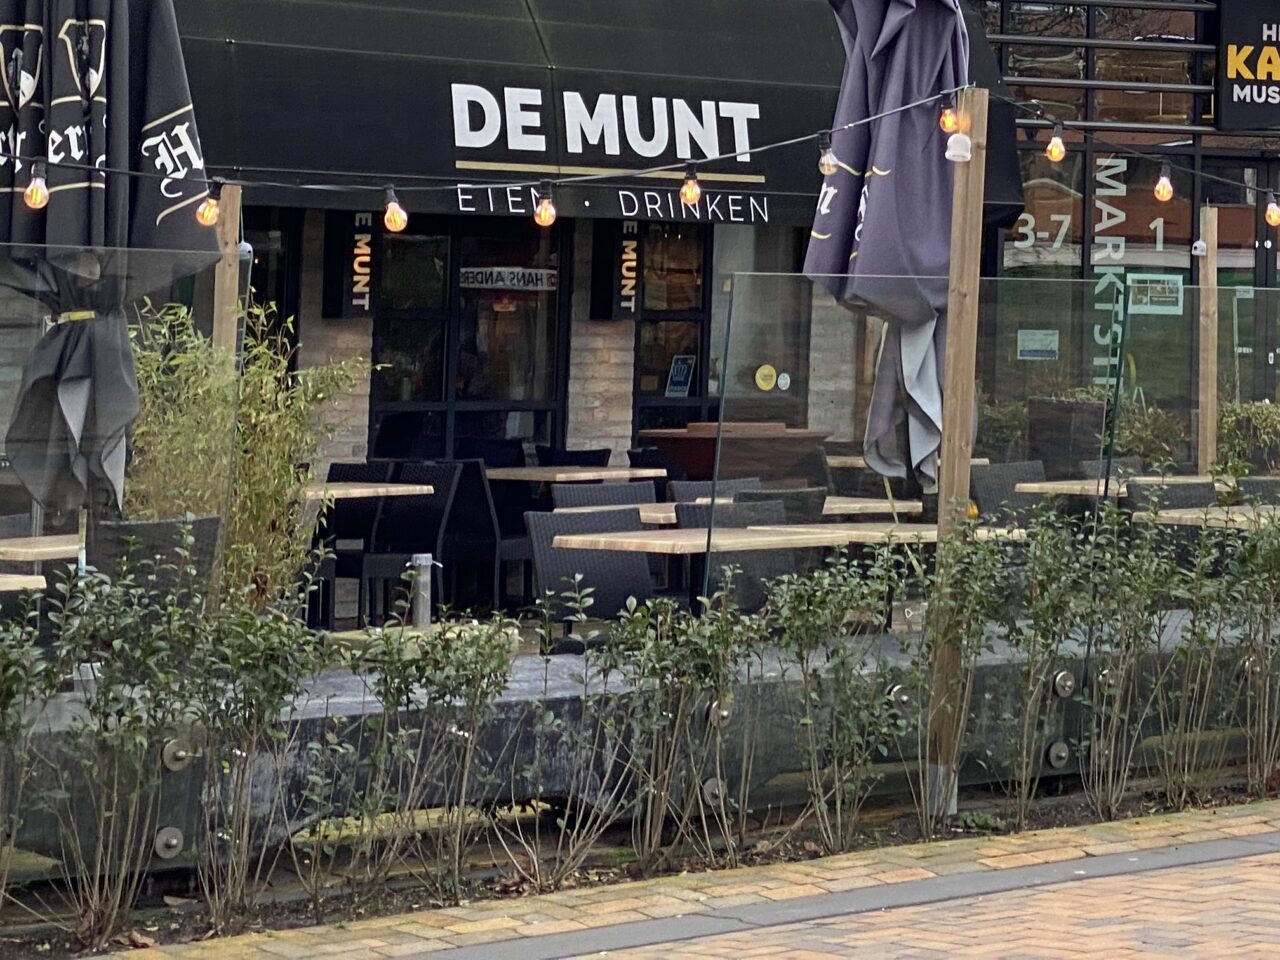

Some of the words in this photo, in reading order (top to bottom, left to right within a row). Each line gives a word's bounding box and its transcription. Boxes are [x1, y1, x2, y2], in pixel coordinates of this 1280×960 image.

[451, 83, 546, 151] DE
[563, 91, 760, 162] MUNT
[1014, 212, 1072, 249] 3-7
[1149, 217, 1164, 251] 1
[352, 233, 372, 310] MUNT
[620, 240, 638, 312] MUNT
